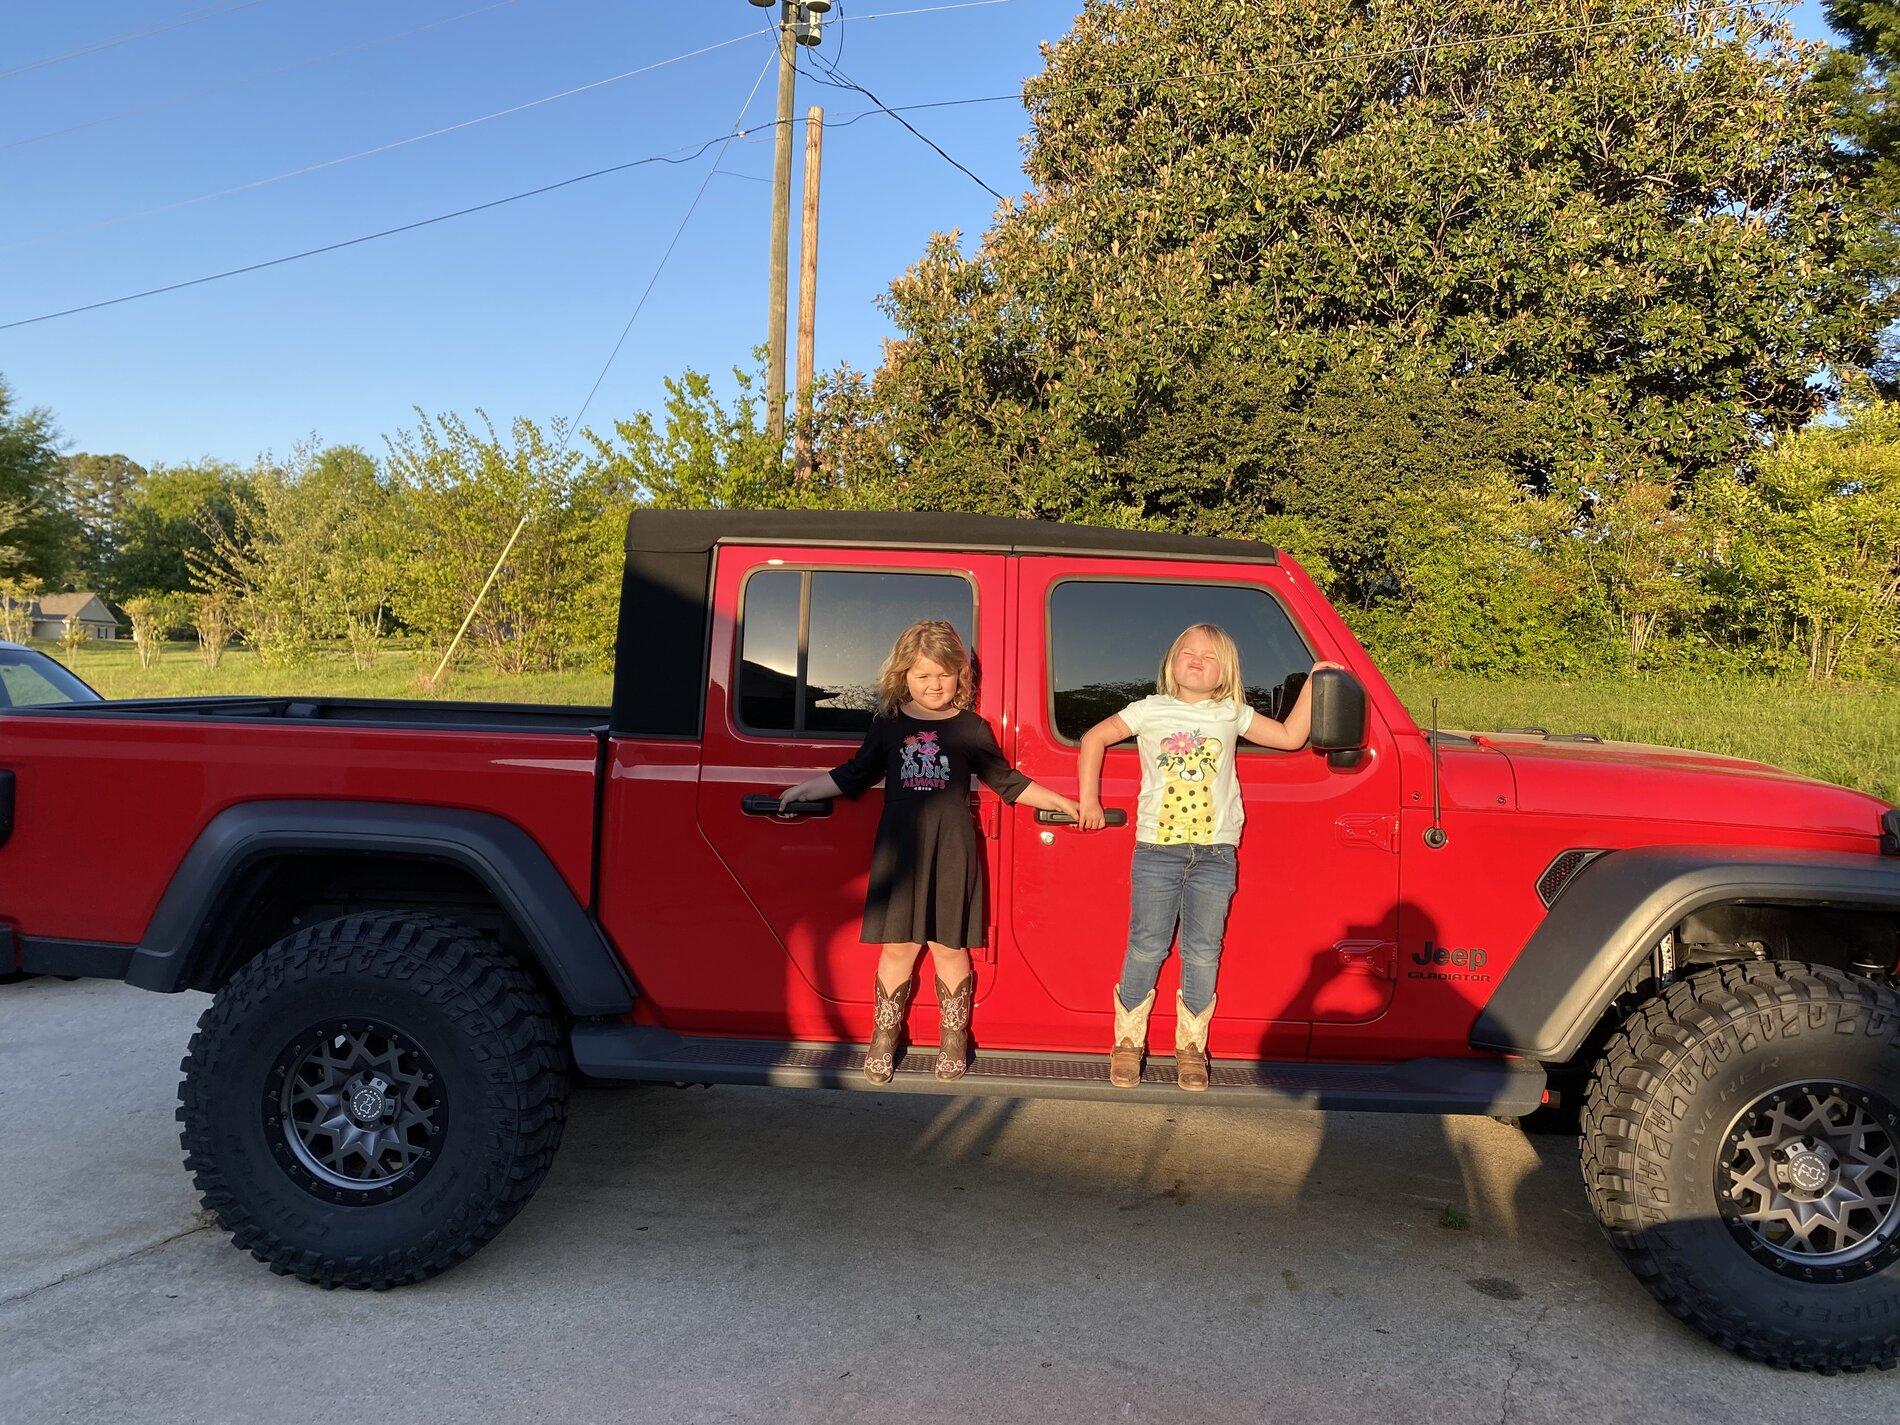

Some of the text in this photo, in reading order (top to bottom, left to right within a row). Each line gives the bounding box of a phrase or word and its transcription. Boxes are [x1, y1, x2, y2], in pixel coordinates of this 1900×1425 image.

[900, 762, 950, 781] MUSIC
[902, 777, 946, 790] ALWAYS
[1412, 941, 1488, 972] Jeep
[1407, 971, 1491, 982] GLADIATOR
